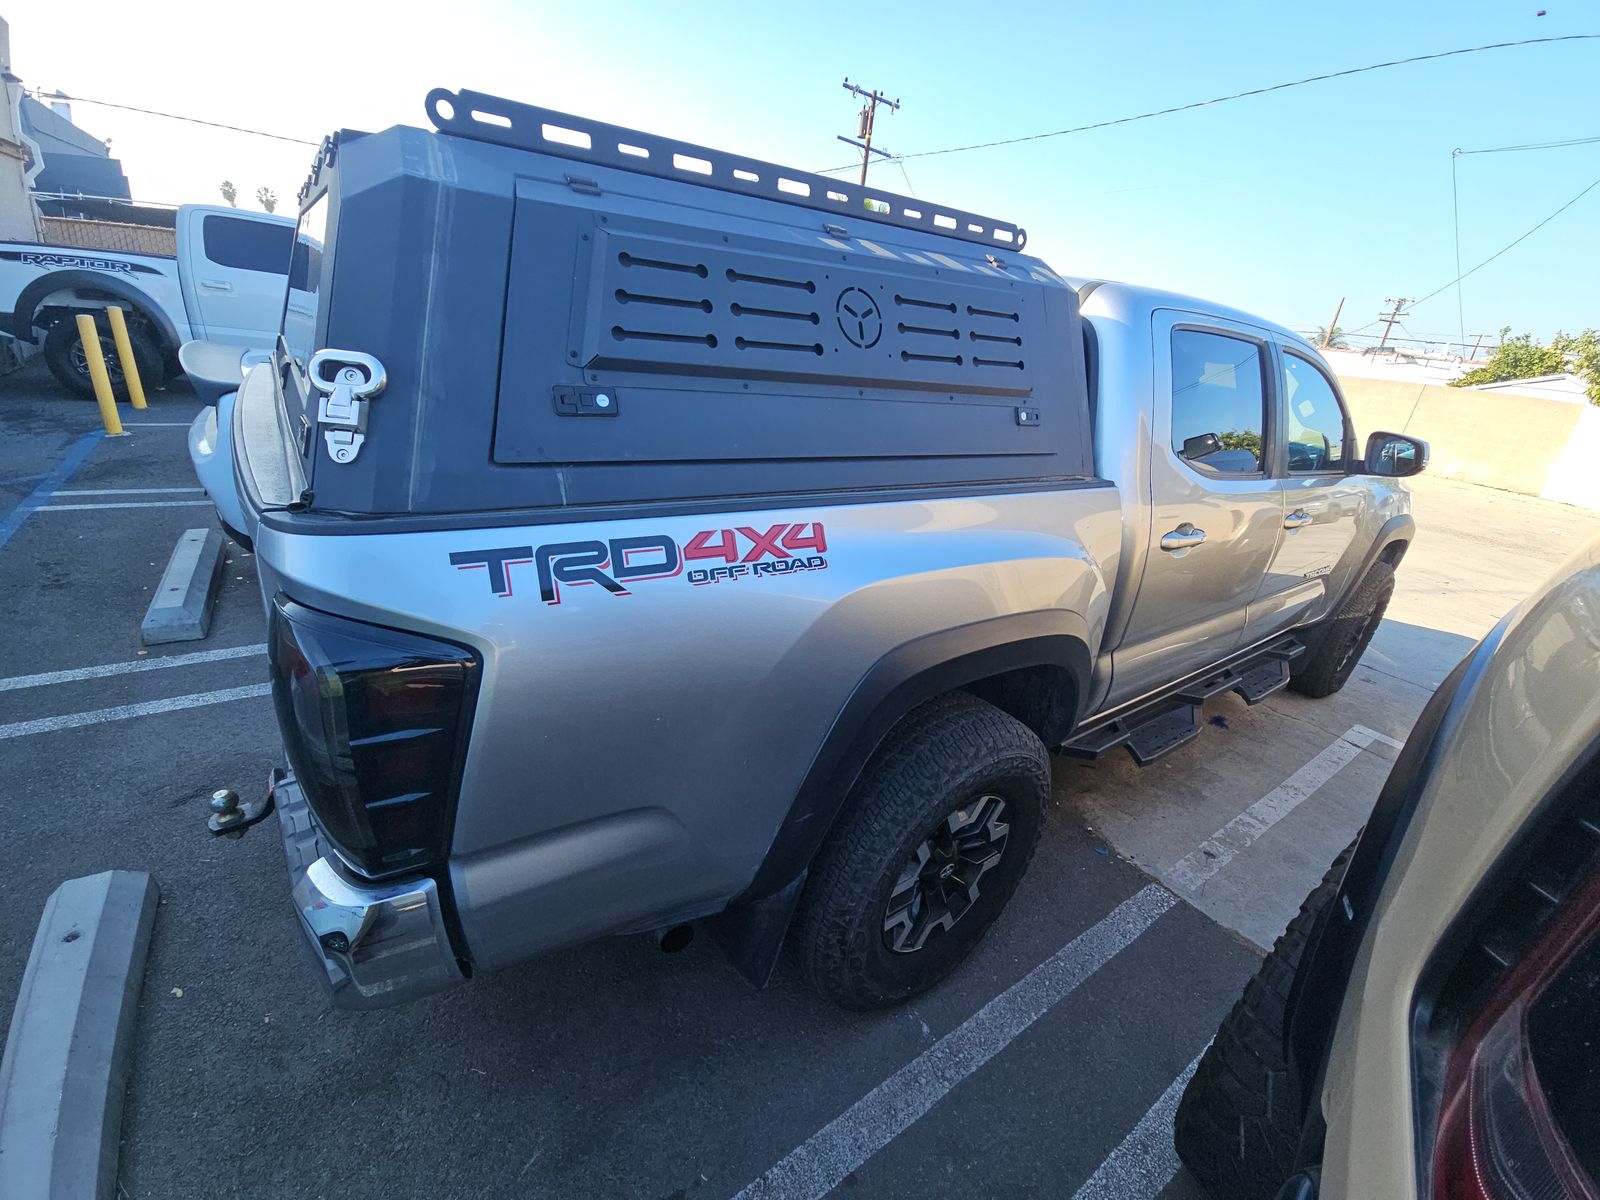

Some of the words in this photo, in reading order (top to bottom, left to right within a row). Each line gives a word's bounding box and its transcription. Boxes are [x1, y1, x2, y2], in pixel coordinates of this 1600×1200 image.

[20, 252, 139, 280] RAPTOR
[449, 534, 684, 606] TRD
[683, 522, 828, 564] 4X4
[686, 563, 750, 586] OFF
[752, 556, 828, 578] ROAD
